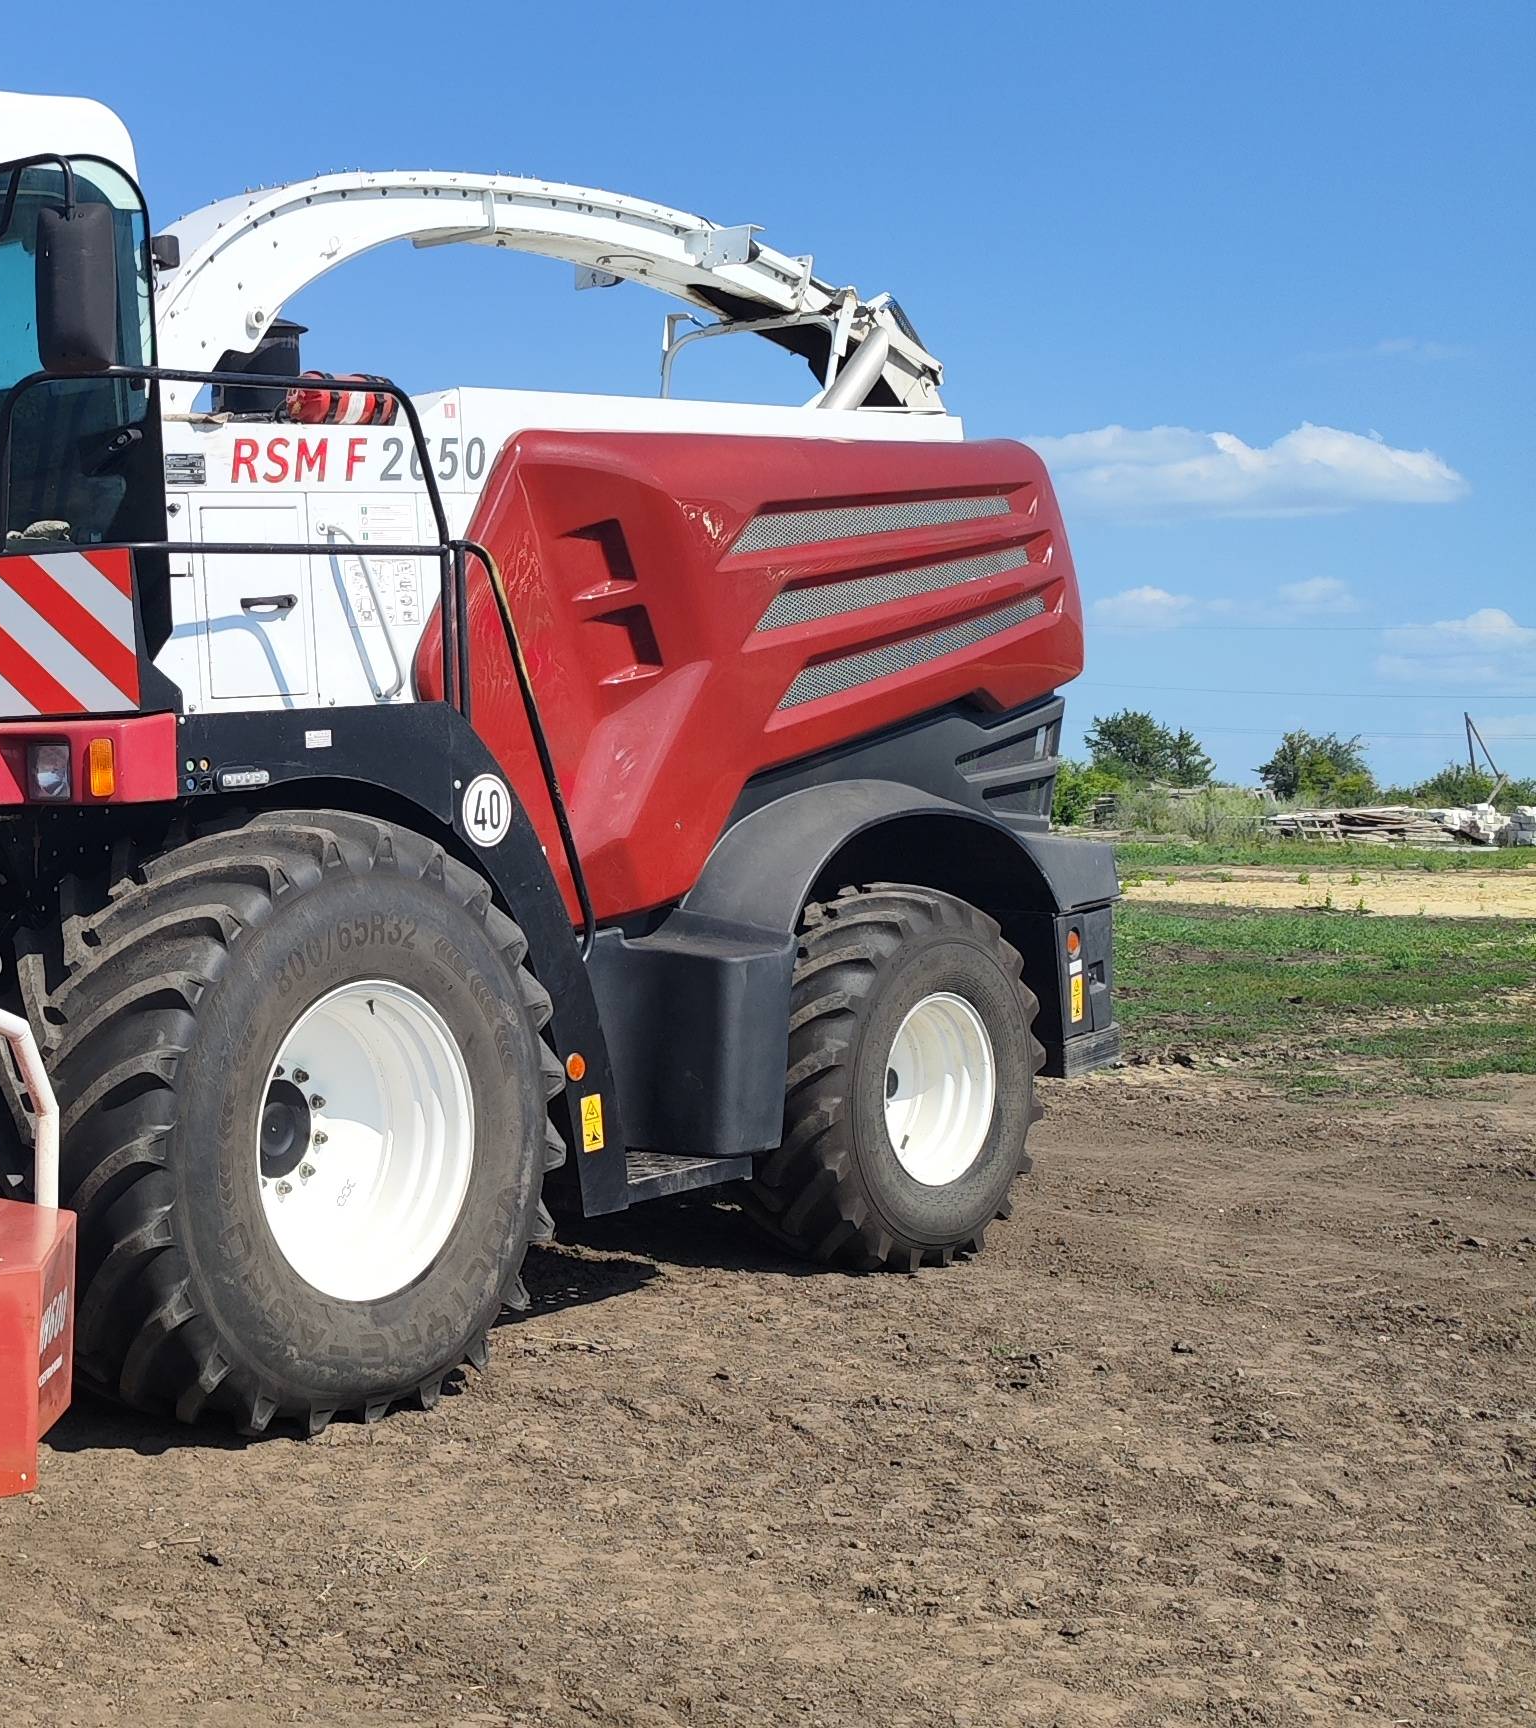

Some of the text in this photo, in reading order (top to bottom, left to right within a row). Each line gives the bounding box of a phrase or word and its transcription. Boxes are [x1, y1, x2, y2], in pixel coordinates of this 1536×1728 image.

[230, 437, 328, 483] RSM
[345, 437, 368, 481] F
[474, 789, 501, 831] 40
[272, 911, 417, 996] 800/65R32
